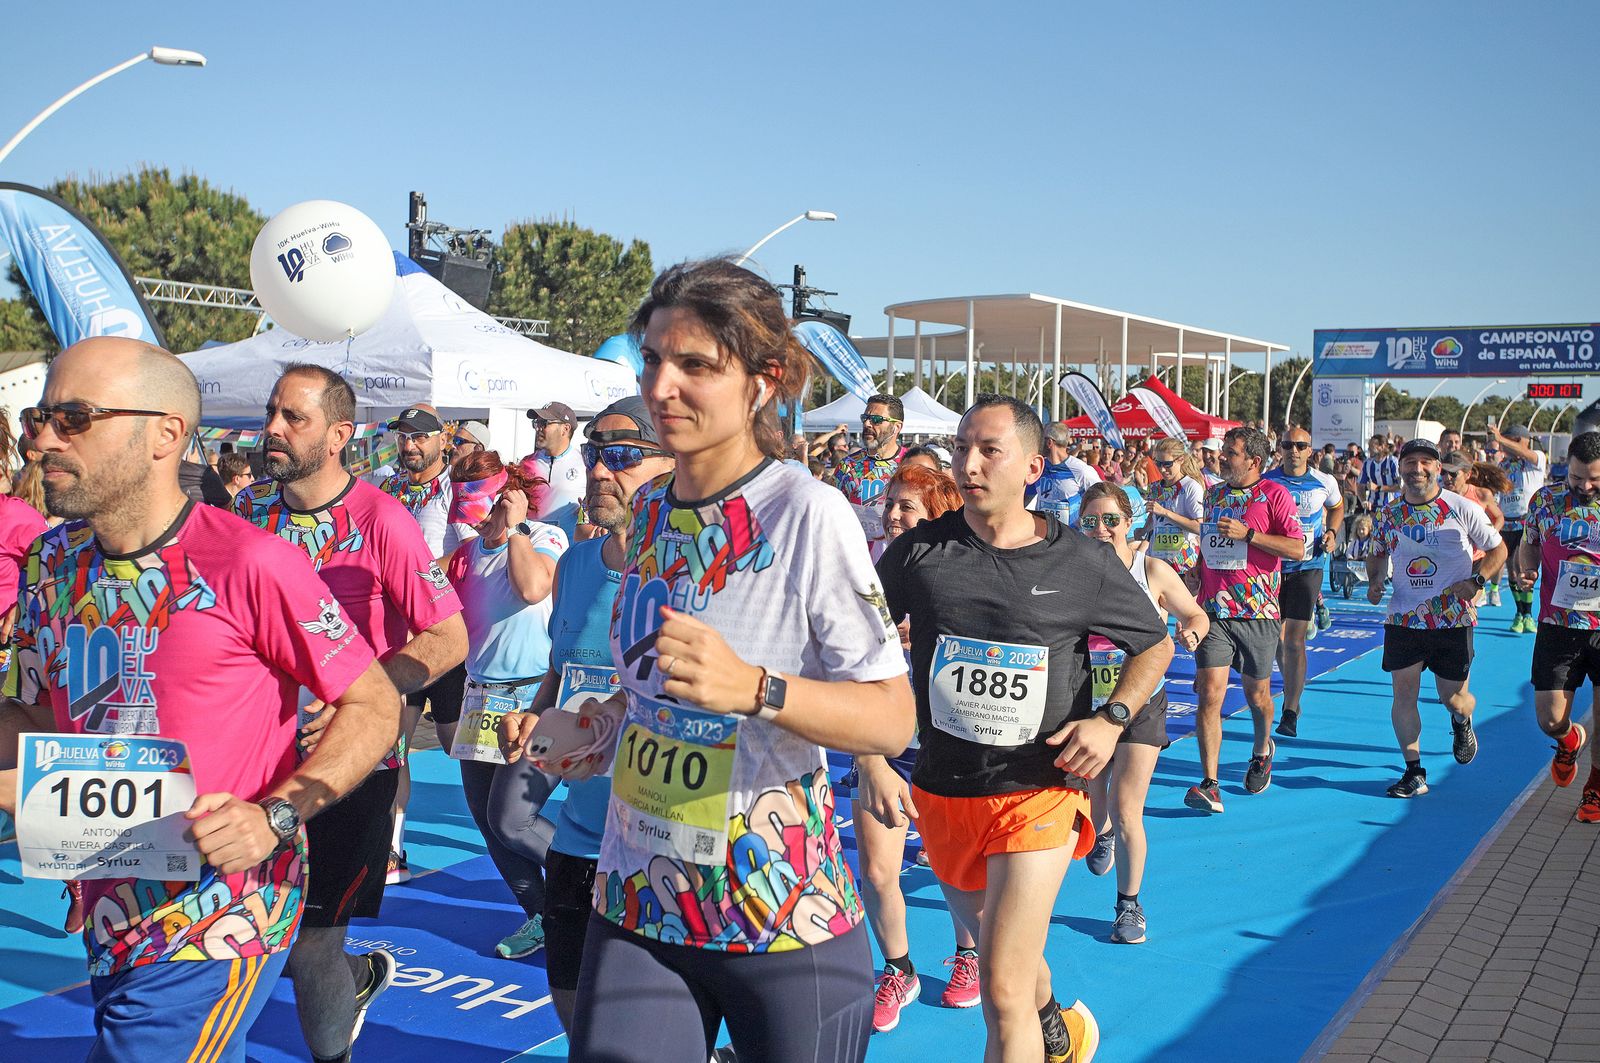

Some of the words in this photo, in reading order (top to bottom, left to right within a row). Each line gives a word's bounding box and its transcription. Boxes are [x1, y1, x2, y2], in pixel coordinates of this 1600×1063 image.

[277, 238, 290, 249] 10K
[277, 247, 305, 283] 10
[1413, 336, 1427, 345] HU
[1480, 330, 1594, 344] CAMPEONATO
[1386, 337, 1413, 370] 10
[1413, 352, 1427, 361] VA
[1478, 348, 1496, 360] de
[1500, 345, 1556, 360] ESPAÑA
[1567, 343, 1593, 361] 10
[1435, 359, 1458, 367] WiHu
[1533, 361, 1551, 369] ruta
[1553, 361, 1592, 369] Absoluto
[1157, 534, 1179, 544] 1319
[1209, 535, 1234, 548] 824
[1410, 579, 1433, 587] WiHu
[1569, 575, 1598, 591] 944
[671, 580, 711, 612] HU
[121, 626, 159, 654] HU
[559, 648, 602, 659] CARRERA
[944, 640, 960, 661] 10
[959, 646, 984, 657] HUELVA
[1008, 651, 1039, 666] 2023
[121, 652, 156, 679] EL
[66, 624, 121, 732] 10
[570, 669, 586, 692] 10
[584, 674, 607, 685] HUELVA
[951, 665, 1029, 701] 1885
[121, 678, 157, 705] VA
[494, 701, 514, 711] 2023
[954, 699, 980, 709] JAVIER
[980, 700, 1017, 714] AUGUSTO
[468, 712, 502, 732] 1768
[950, 707, 991, 720] ZAMBRANO
[991, 713, 1020, 724] MACIAS
[682, 718, 724, 741] 2023
[973, 724, 1003, 736] Syrluz
[35, 740, 60, 772] 10
[58, 747, 100, 761] HUELVA
[105, 760, 126, 769] WiHu
[136, 746, 179, 767] 2023
[628, 730, 708, 790] 1010
[50, 777, 162, 819] 1601
[638, 785, 668, 803] MANOLI
[650, 804, 685, 823] MILLAN
[82, 828, 133, 838] ANTONIO
[638, 819, 672, 841] Syrluz
[61, 840, 102, 850] RIVERA
[103, 842, 156, 851] CASTILLA
[38, 861, 88, 871] HYUNDAI
[96, 855, 141, 868] Syrluz
